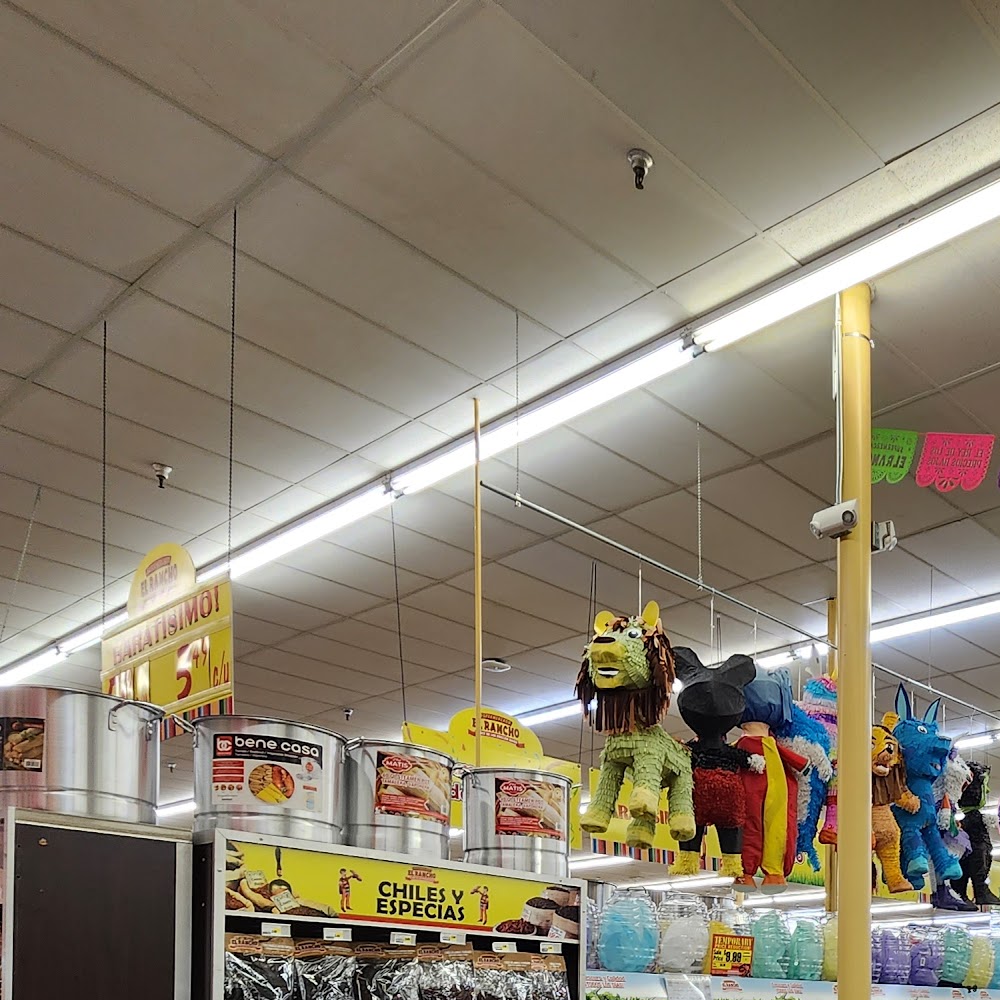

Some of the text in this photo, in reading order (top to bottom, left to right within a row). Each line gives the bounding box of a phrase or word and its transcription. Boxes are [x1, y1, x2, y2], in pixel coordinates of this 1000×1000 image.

[235, 736, 278, 750] bene
[280, 742, 319, 757] casa
[385, 760, 409, 769] MATIS
[502, 784, 524, 792] MATIS
[378, 881, 464, 905] CHILES Y
[376, 898, 465, 922] ESPECIAS
